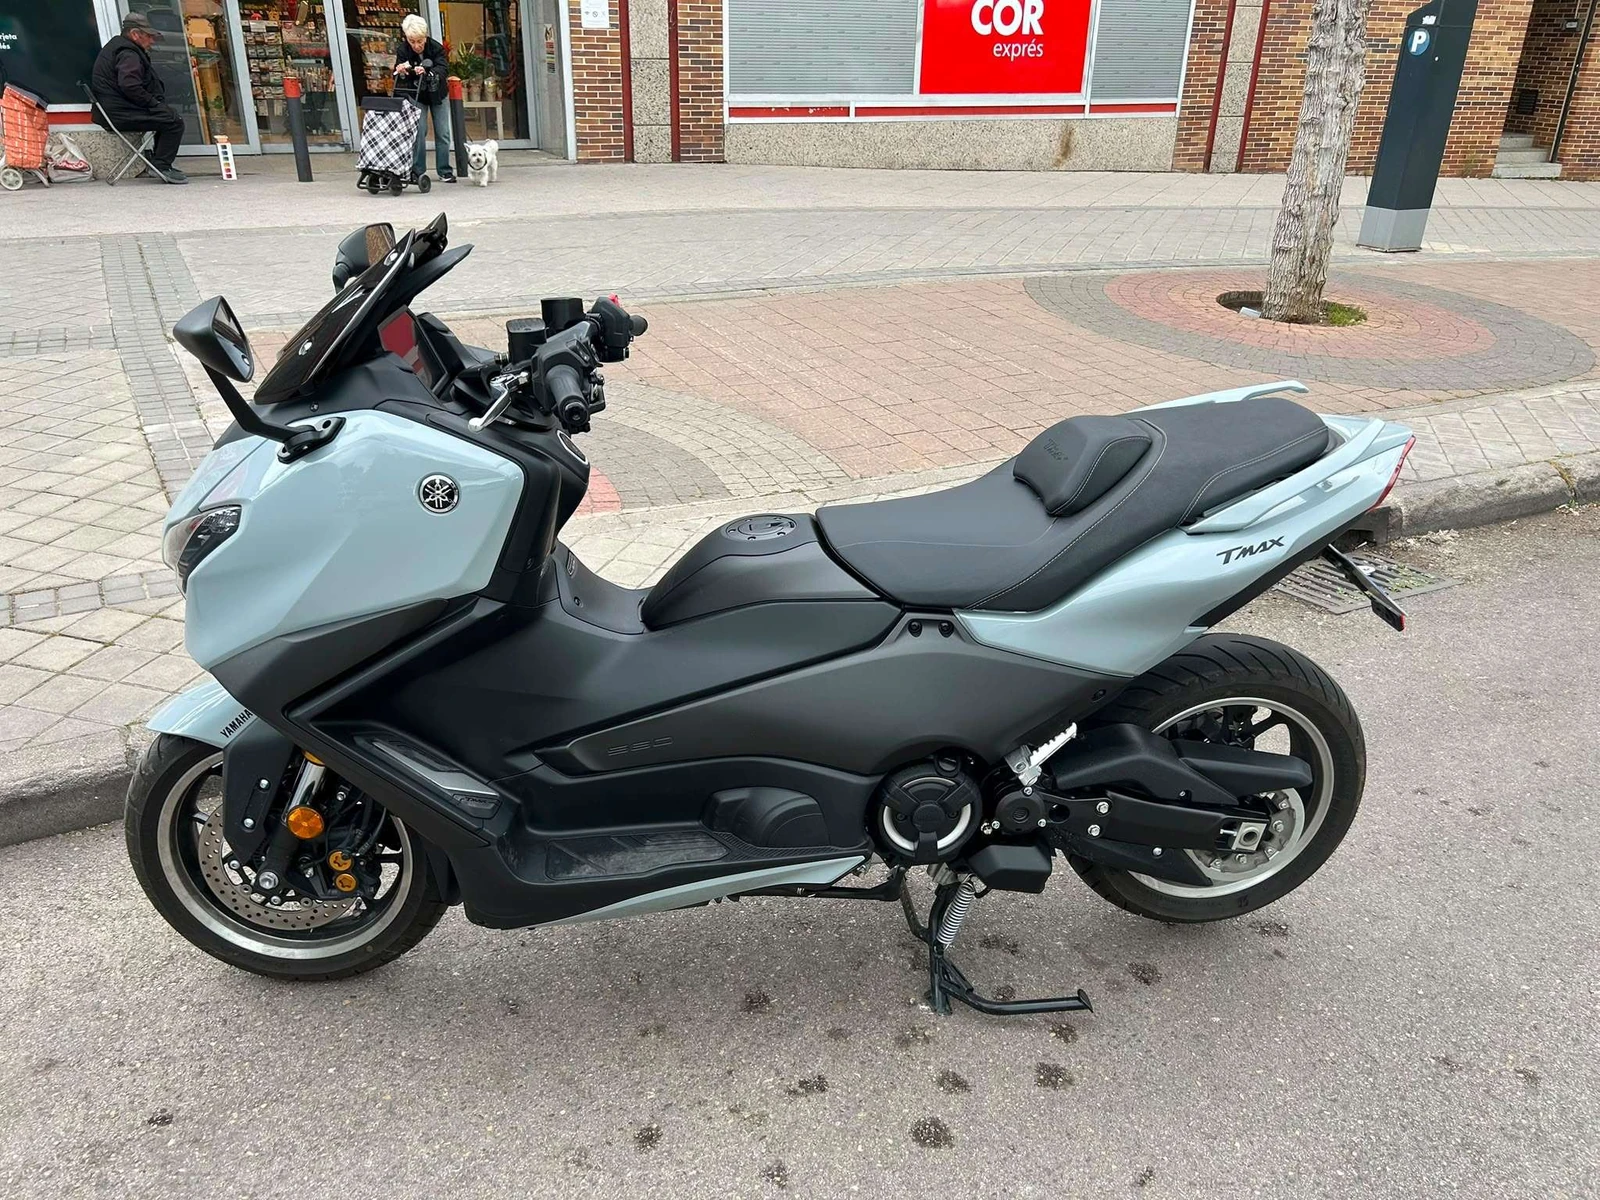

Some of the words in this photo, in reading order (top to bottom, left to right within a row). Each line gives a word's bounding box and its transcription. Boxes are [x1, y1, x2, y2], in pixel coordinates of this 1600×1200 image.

[971, 0, 1044, 36] COR
[993, 38, 1044, 62] exprés
[1410, 31, 1427, 53] P
[1216, 535, 1285, 565] TMAX
[220, 709, 253, 738] YAMAHA
